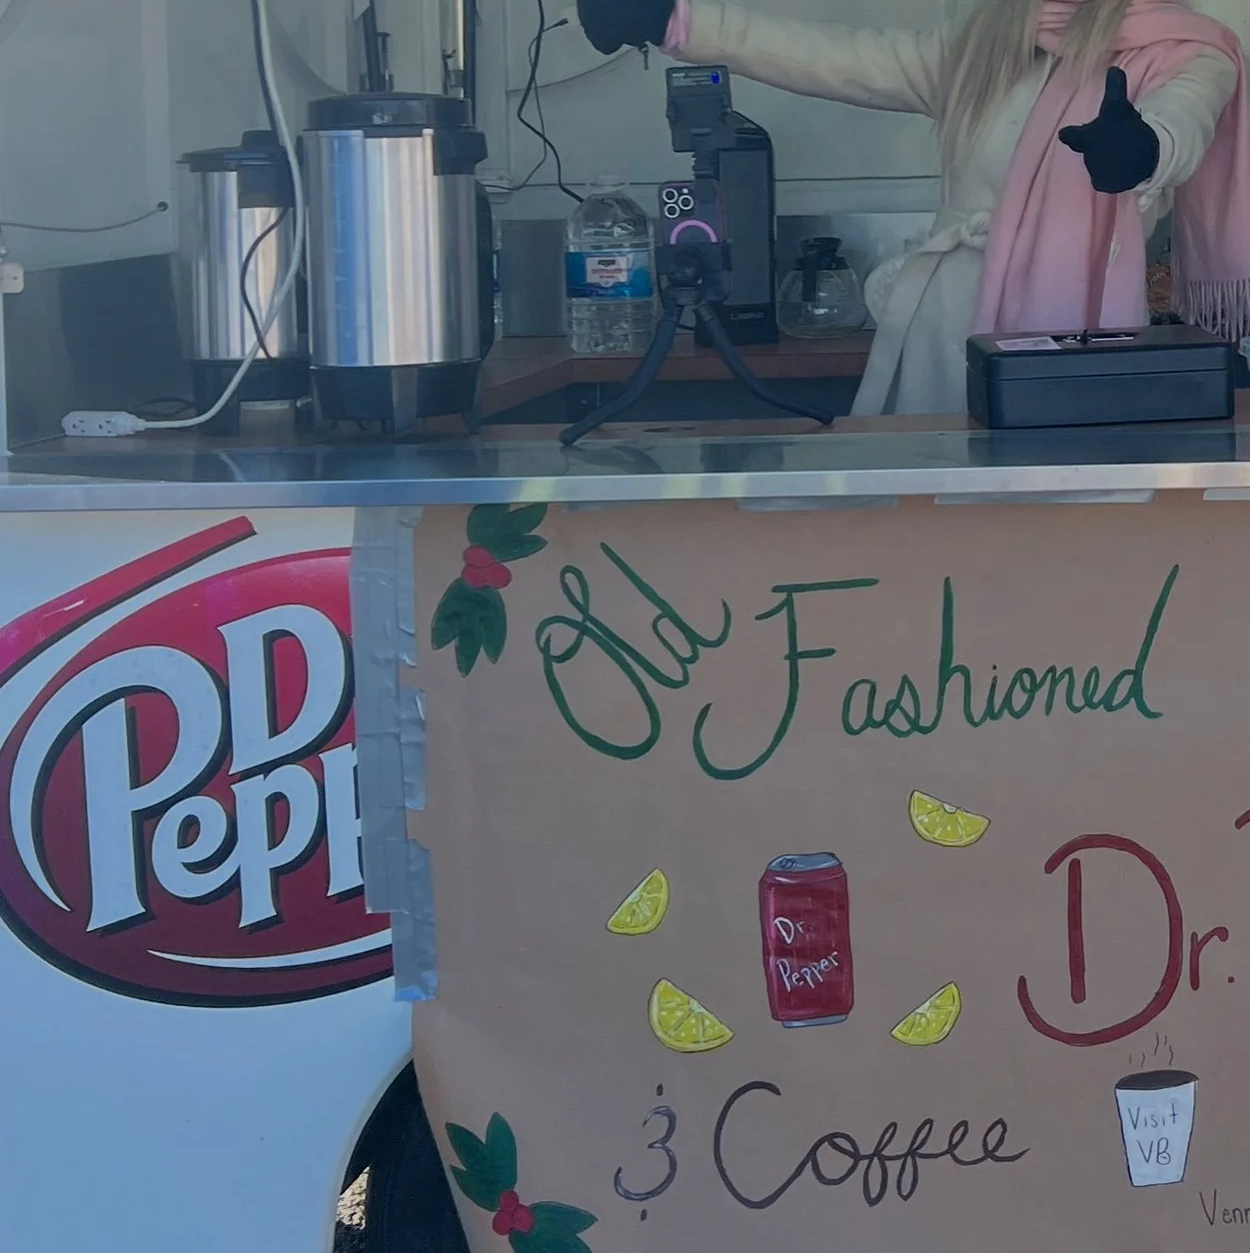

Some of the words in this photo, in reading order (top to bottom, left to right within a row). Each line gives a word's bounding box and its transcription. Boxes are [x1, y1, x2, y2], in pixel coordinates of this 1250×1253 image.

[217, 603, 350, 777] D
[535, 542, 731, 761] Old
[693, 564, 1180, 781] Fashioned
[777, 950, 839, 993] Pepper
[1017, 833, 1235, 1047] Dr.
[713, 1079, 1031, 1209] Coffee
[1127, 1102, 1179, 1131] Visit
[1136, 1136, 1173, 1166] VB
